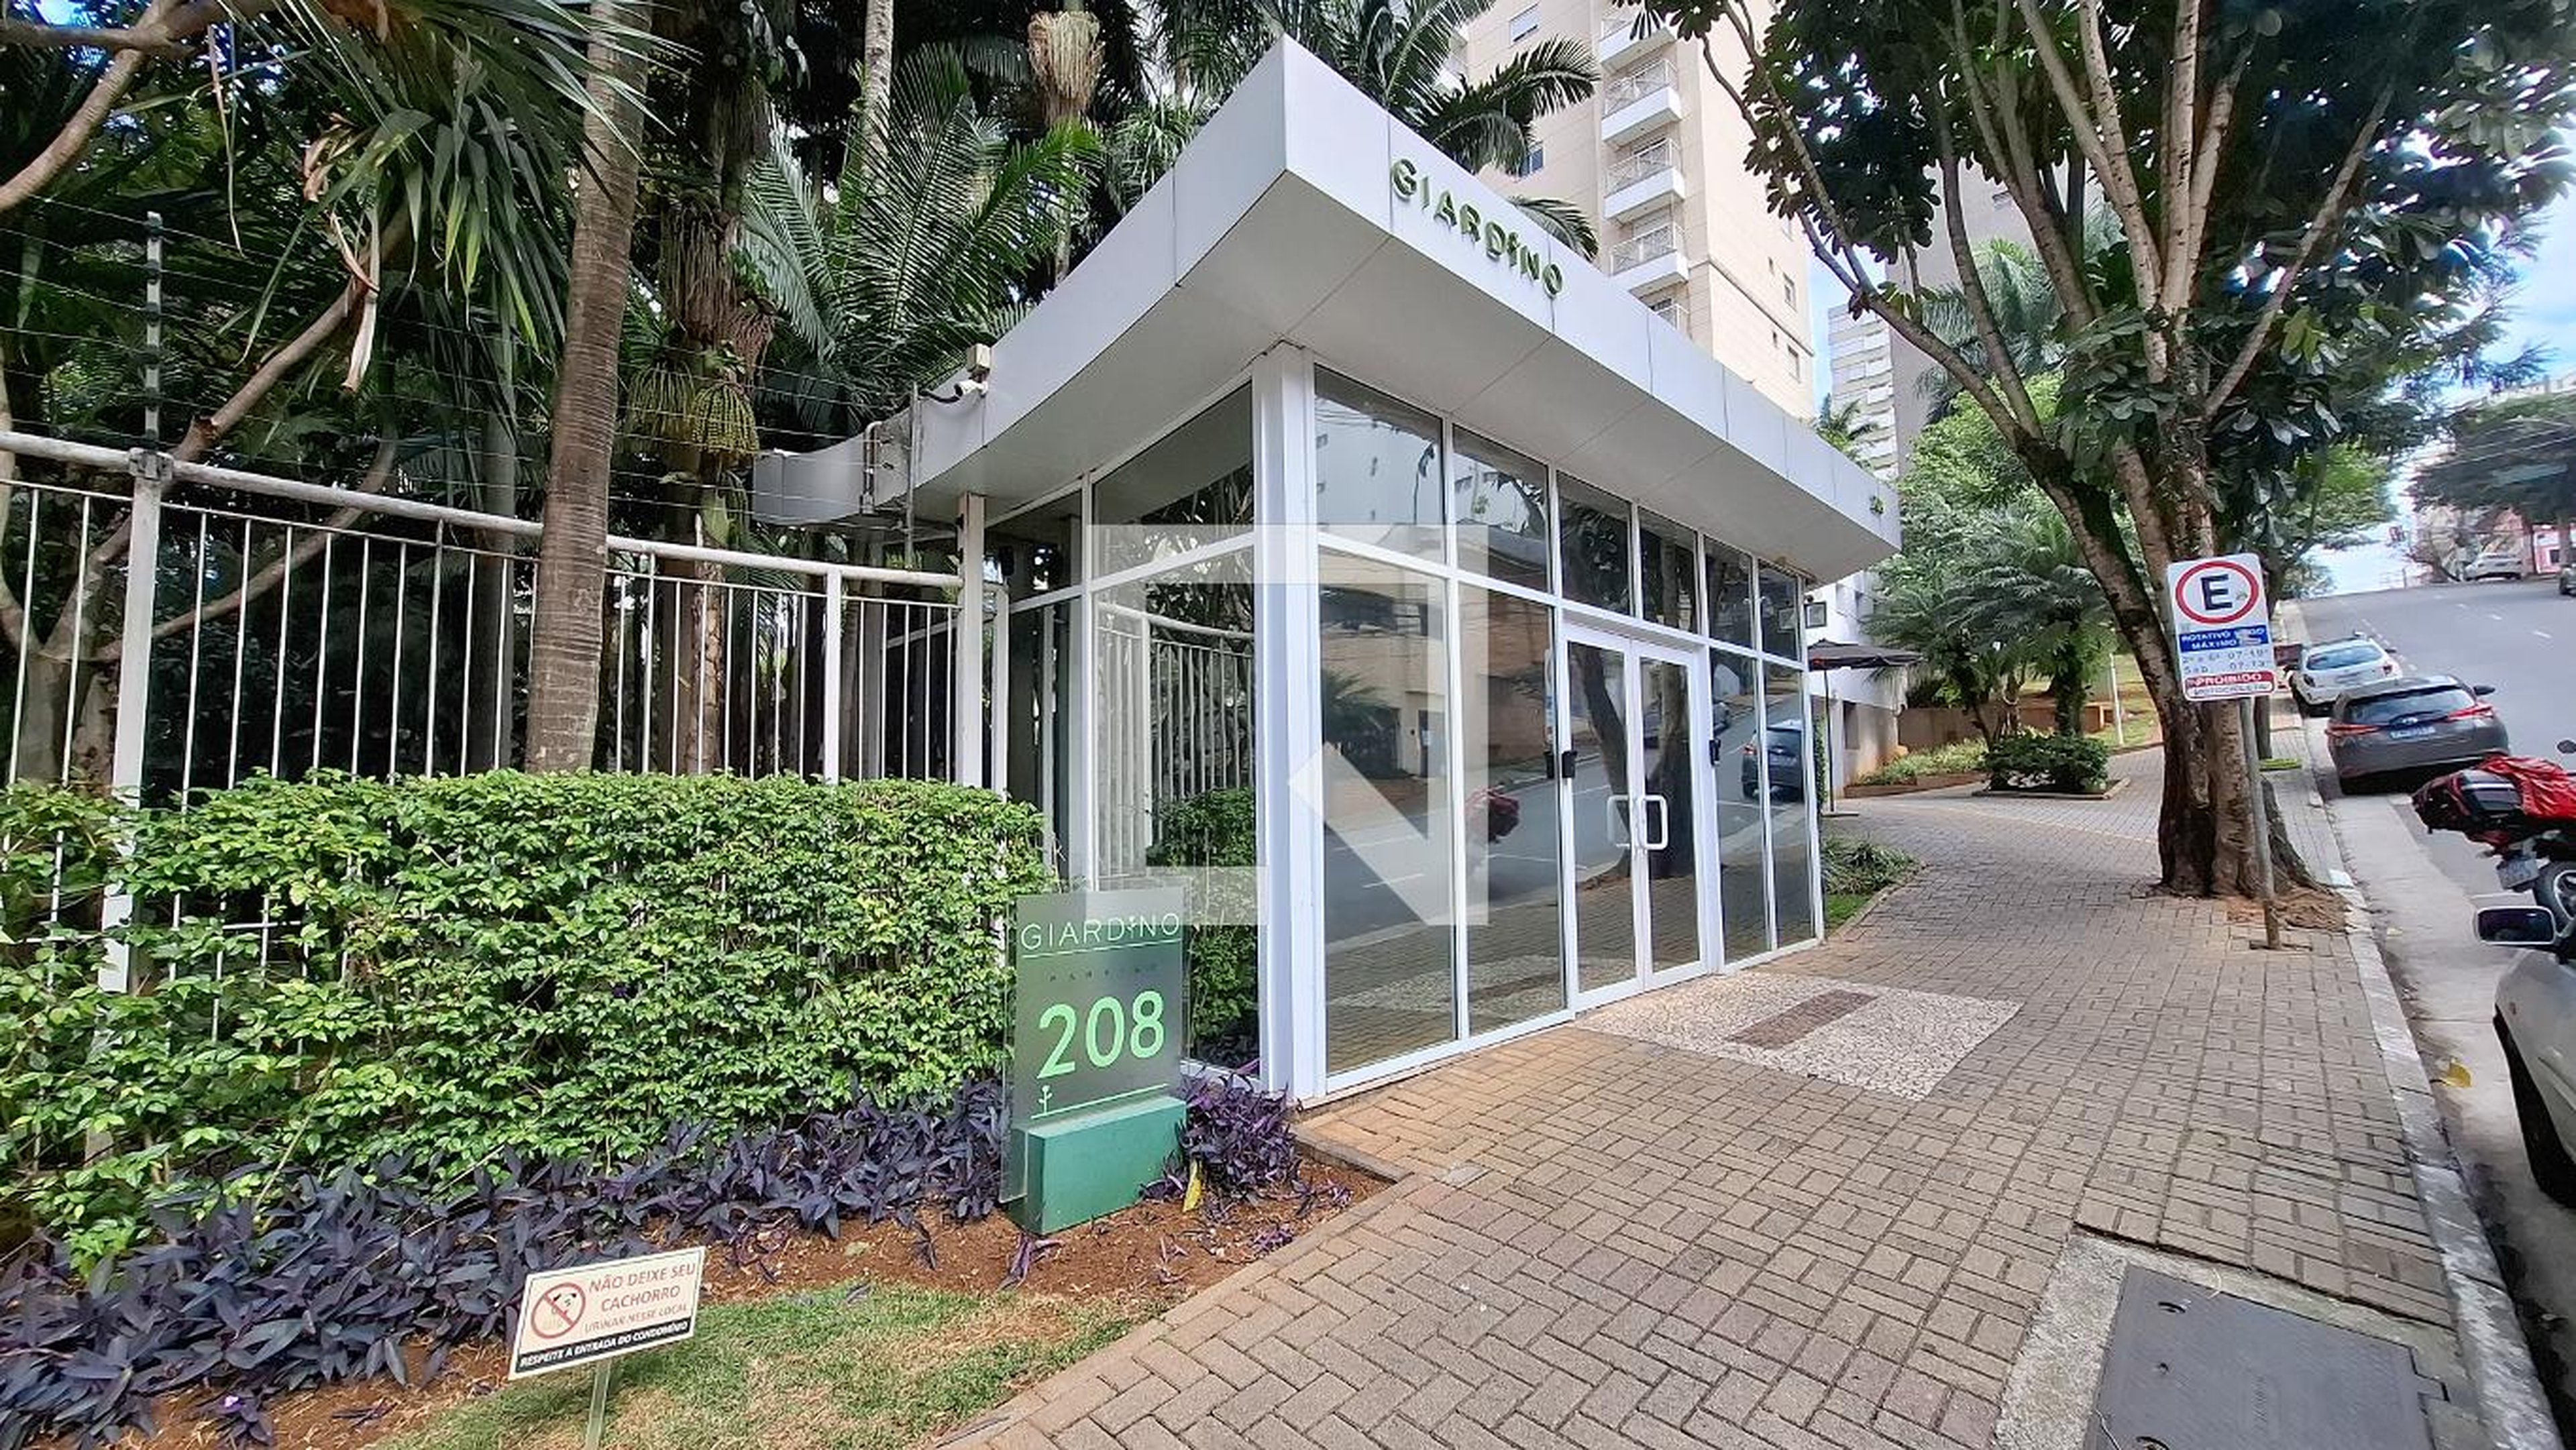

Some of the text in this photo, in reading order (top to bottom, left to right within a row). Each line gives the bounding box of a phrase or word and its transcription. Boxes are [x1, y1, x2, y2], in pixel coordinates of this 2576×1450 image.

[1391, 158, 1563, 296] GIARDINO
[2200, 573, 2233, 611] E
[1020, 913, 1179, 950] GIARDINO
[1036, 991, 1165, 1079] 208
[589, 1263, 696, 1293] NÃO DEIXE SEU
[601, 1285, 681, 1313] CACHORRO
[585, 1315, 625, 1333] URINAR
[659, 1304, 687, 1317] LOCAL
[520, 1349, 563, 1368] RESPEITE
[566, 1346, 573, 1357] A
[574, 1336, 616, 1355] ENTRADA
[617, 1335, 632, 1345] DO
